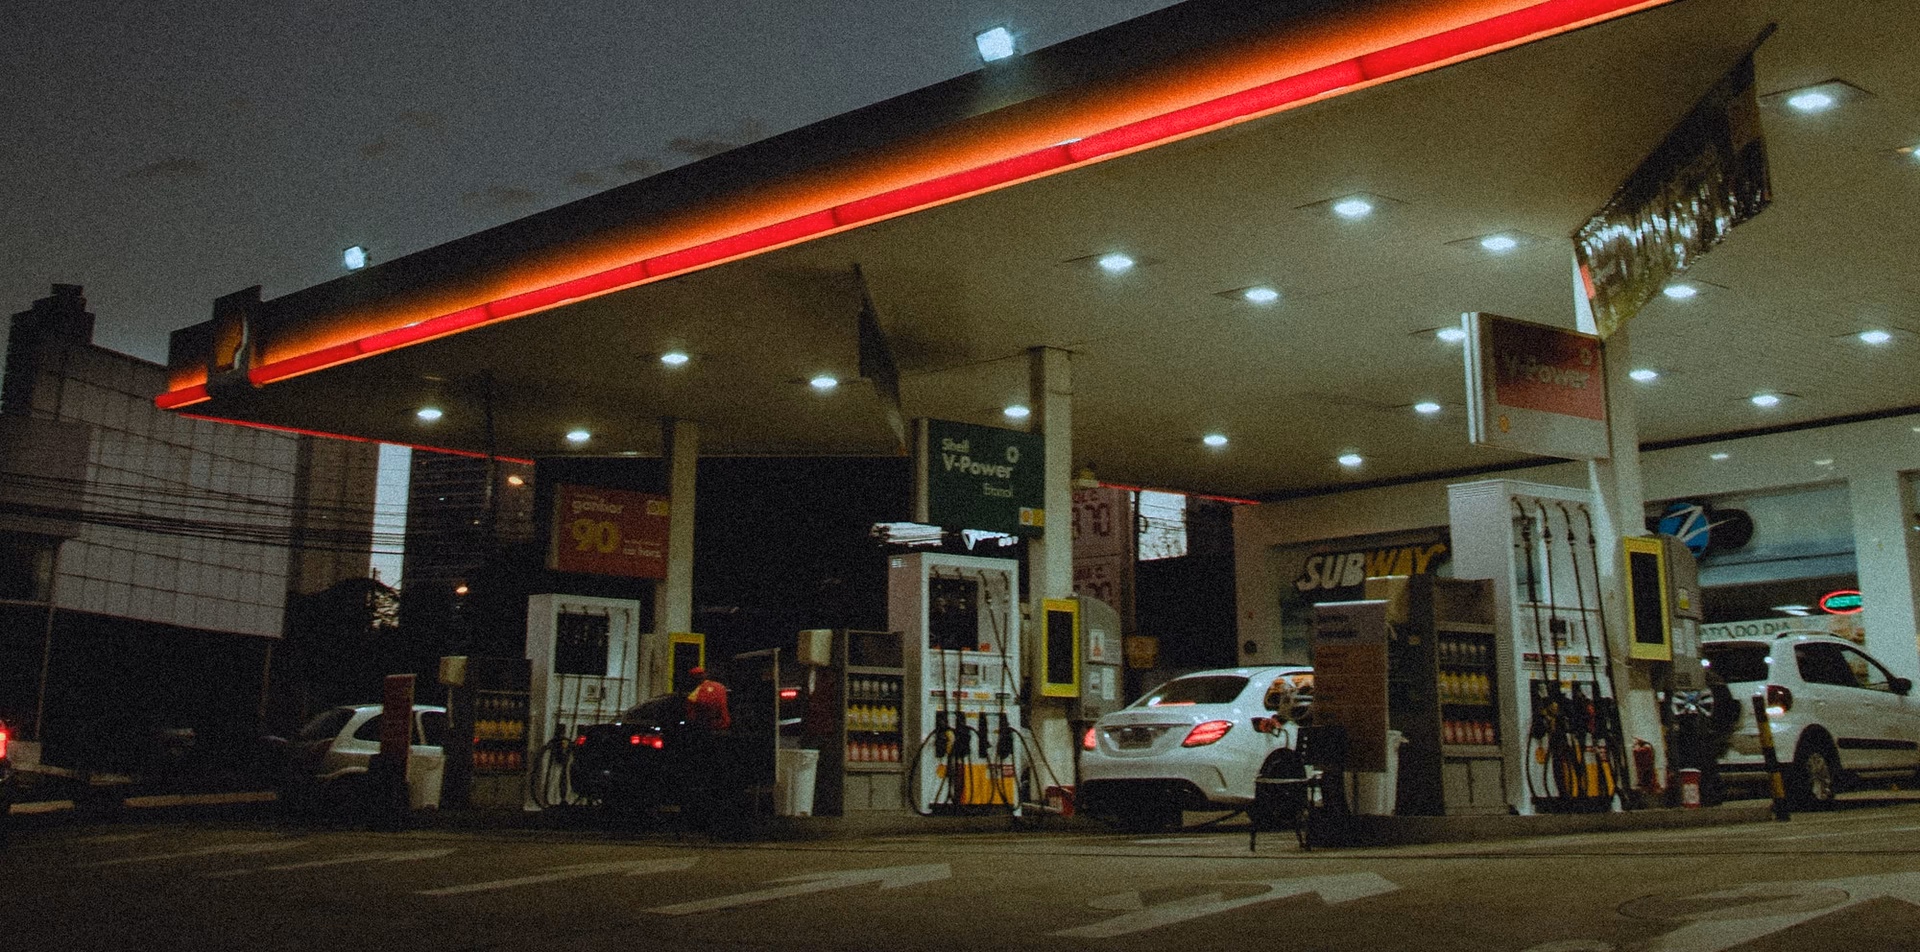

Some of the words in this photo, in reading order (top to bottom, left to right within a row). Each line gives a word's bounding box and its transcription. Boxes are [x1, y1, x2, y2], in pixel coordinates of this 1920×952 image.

[1502, 349, 1590, 389] V-Power
[941, 438, 971, 453] Shell
[941, 453, 1014, 479] V-Power
[571, 518, 621, 554] 90
[1296, 543, 1448, 591] SUBWAY
